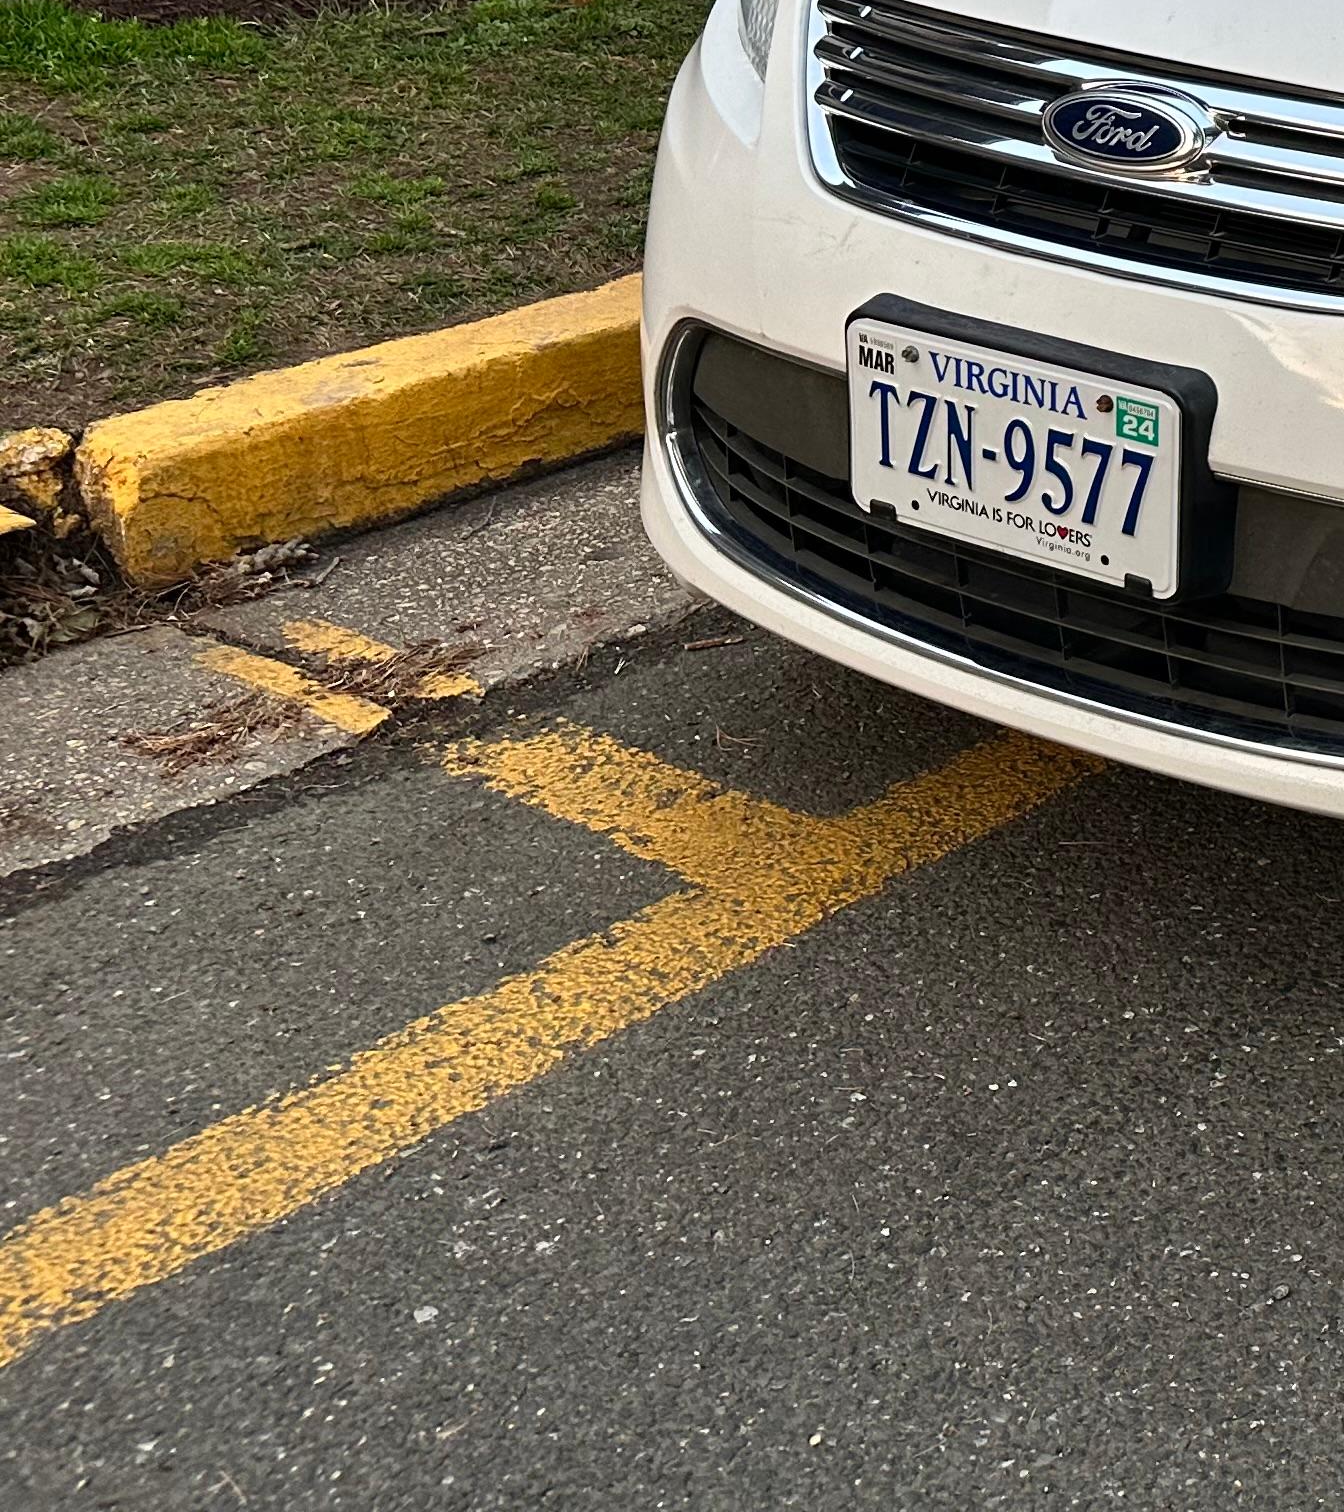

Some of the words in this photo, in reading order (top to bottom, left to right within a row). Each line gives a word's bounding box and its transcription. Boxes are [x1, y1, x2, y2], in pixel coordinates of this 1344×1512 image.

[1072, 104, 1160, 152] Ford
[859, 344, 895, 375] MAR
[928, 351, 1087, 420] VIRGINIA
[1123, 414, 1155, 441] 24
[868, 380, 1155, 537] TZN-9577
[926, 488, 989, 520] VIRGINIA
[992, 506, 1002, 523] IS
[1006, 510, 1036, 533] FOR
[1036, 536, 1091, 562] Virginia.org
